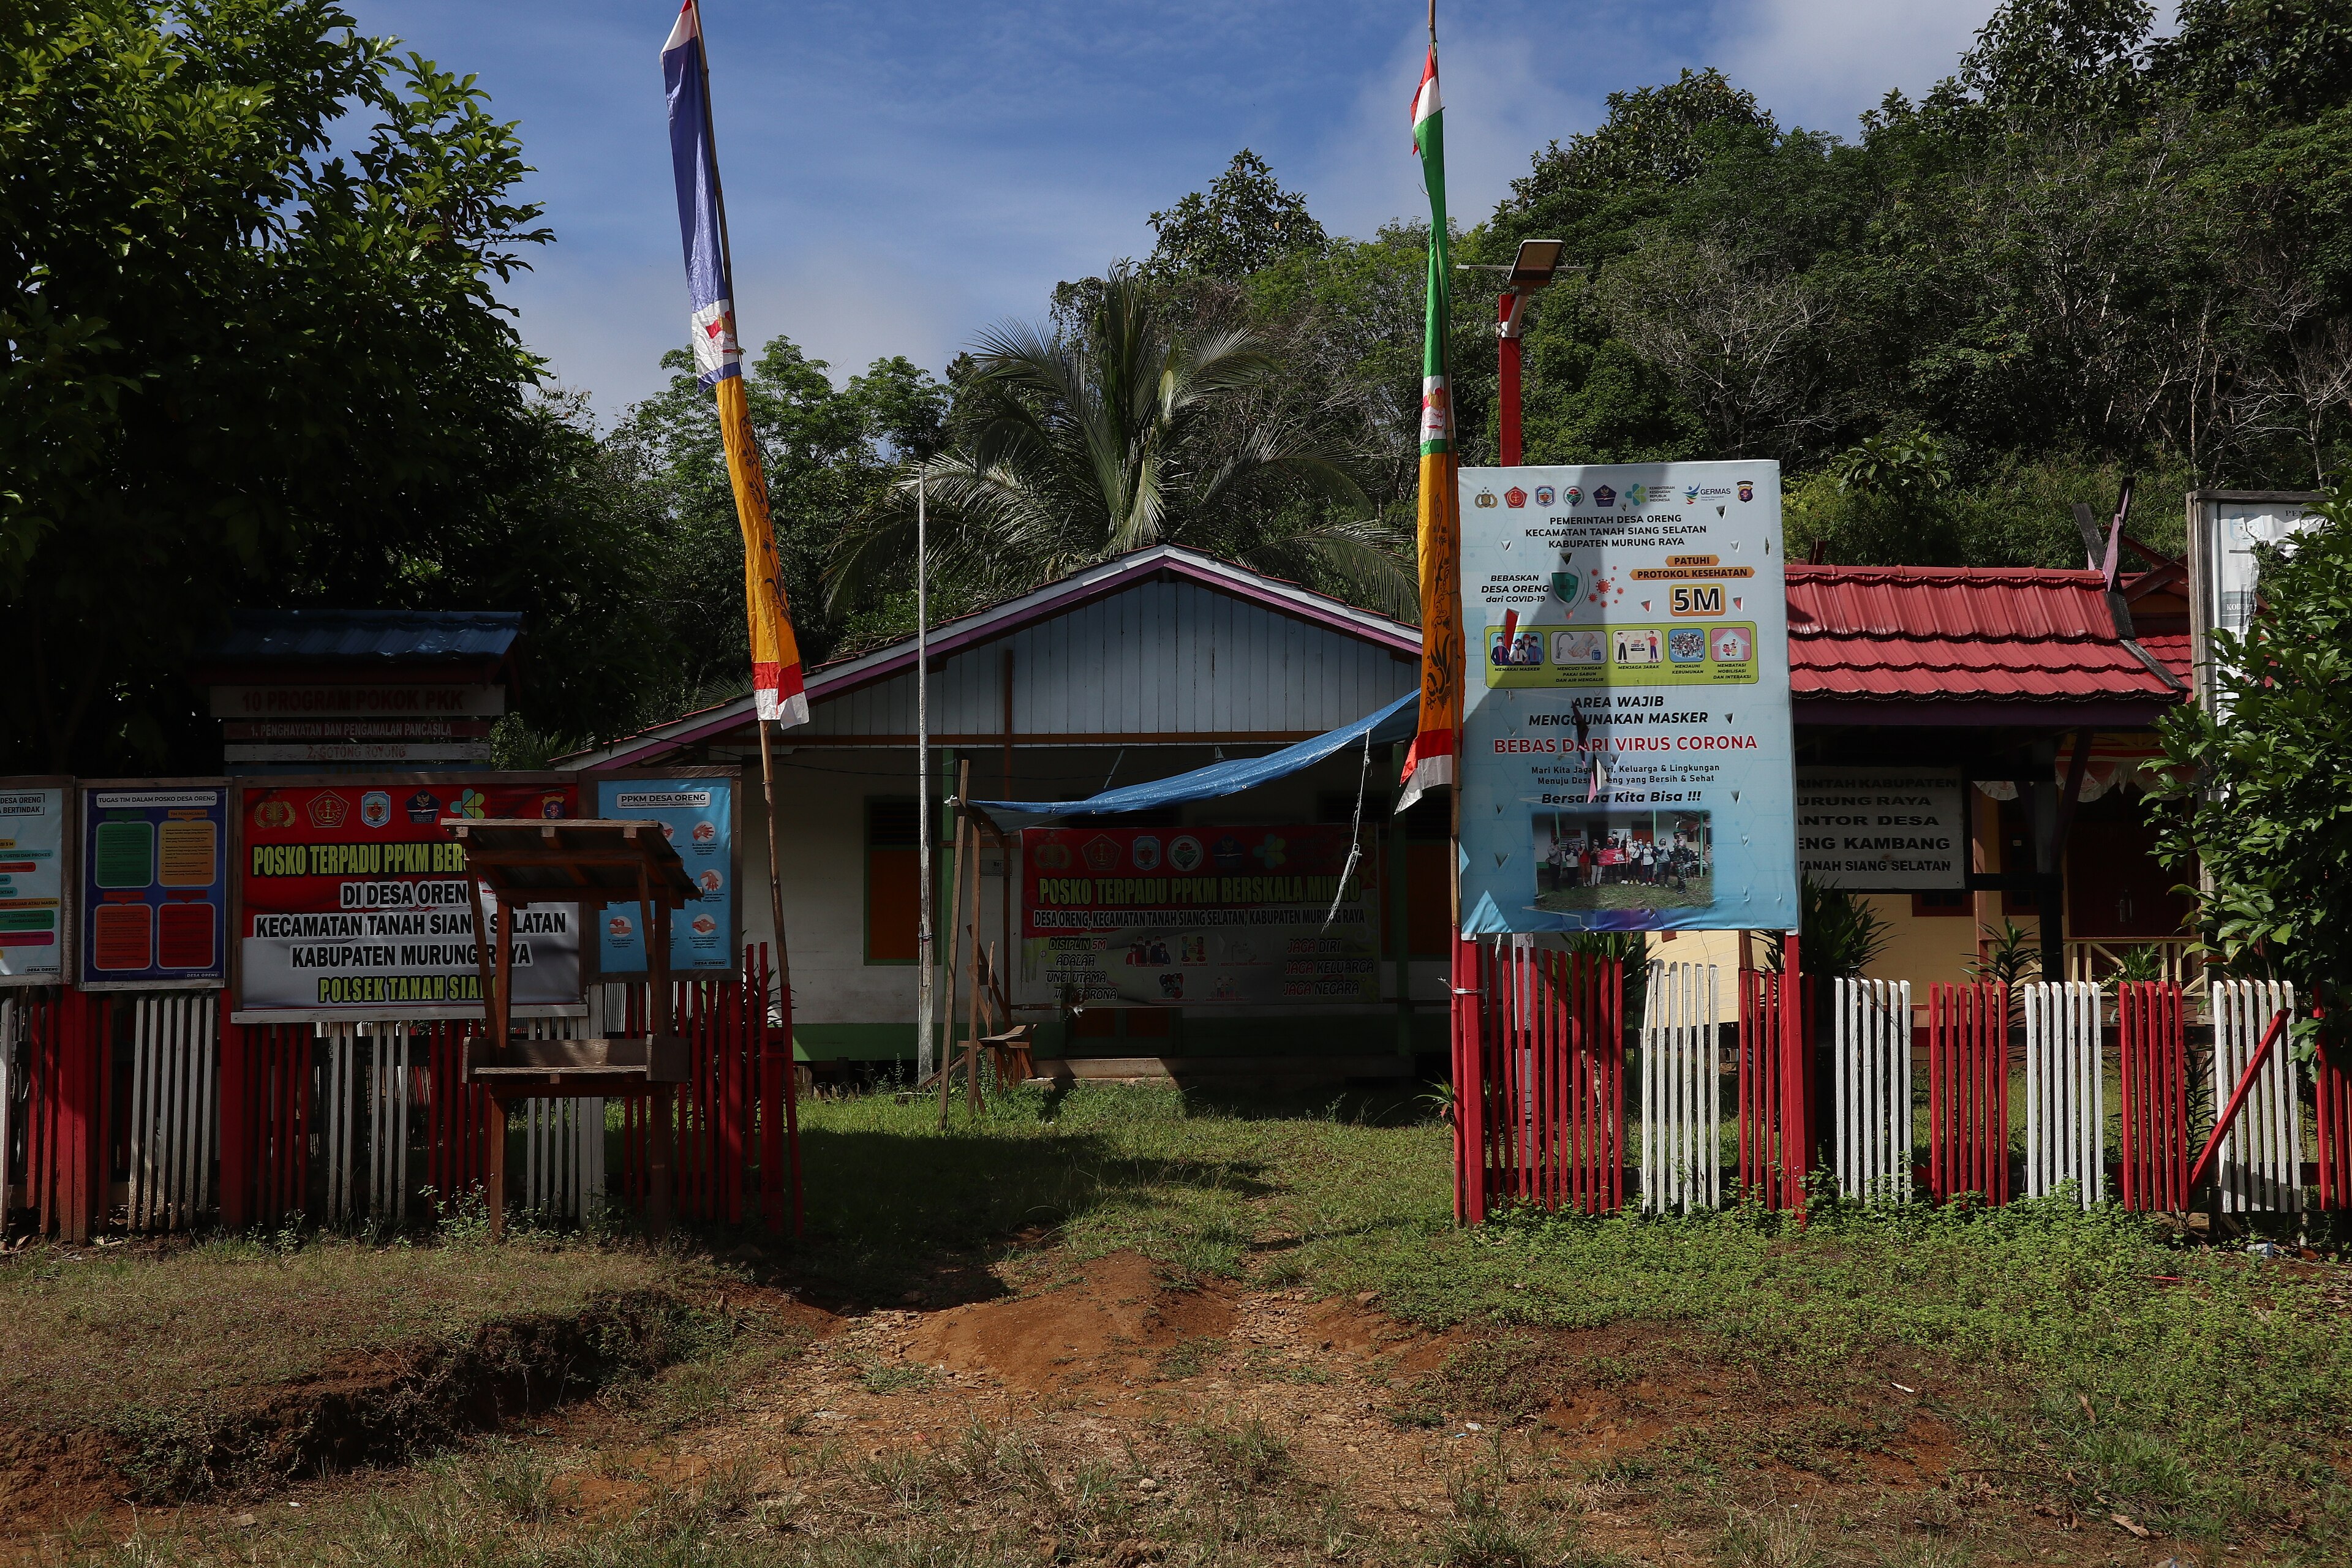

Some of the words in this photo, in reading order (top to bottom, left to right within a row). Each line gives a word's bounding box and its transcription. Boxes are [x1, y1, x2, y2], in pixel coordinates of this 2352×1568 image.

[1550, 516, 1613, 525] PEMERINTAH
[1616, 515, 1644, 524] DESA
[1525, 528, 1586, 537] KECAMATAN
[1589, 527, 1624, 536] TANAH
[1627, 527, 1659, 535] SIANG
[1662, 526, 1707, 534] SELATAN
[1548, 540, 1608, 548] KABUPATEN
[1611, 538, 1655, 547] MURUNG
[1692, 568, 1747, 578] KESEHATAN
[1675, 588, 1720, 611] 5M
[243, 692, 262, 711] 10
[267, 690, 351, 711] PROGRAM
[356, 690, 419, 710] POKOK
[425, 690, 465, 710] PKK
[1571, 697, 1612, 709] AREA
[1617, 696, 1664, 707] WAJIB
[1648, 712, 1708, 723] MASKER
[260, 724, 322, 737] PENGHAYATAN
[324, 723, 342, 736] DAN
[344, 723, 402, 736] PENGAMALAN
[404, 723, 452, 736] PANCASILA
[1494, 739, 1556, 753] BEBAS
[1615, 737, 1670, 751] VIRUS
[1677, 736, 1757, 750] CORONA
[319, 745, 361, 760] GOTONG
[1573, 766, 1593, 775] Jaga
[1619, 765, 1657, 774] Keluarga
[1670, 764, 1720, 773] Lingkungan
[1537, 777, 1569, 786] Menuju
[1796, 779, 1855, 788] RINTAH
[1858, 778, 1957, 788] KABUPATEN
[1614, 791, 1645, 802] Kita
[1650, 790, 1683, 802] Bisa
[1687, 791, 1702, 801] !!!
[1797, 796, 1872, 806] URUNG
[1876, 796, 1932, 806] RAYA
[1877, 816, 1940, 826] DESA
[1799, 837, 1836, 850] ENG
[1844, 837, 1950, 850] KAMBANG
[253, 845, 306, 875] POSKO
[309, 844, 380, 875] TERPADU
[383, 843, 429, 873] PPKM
[433, 843, 467, 872] BER
[1800, 861, 1841, 872] TANAH
[1845, 861, 1887, 871] SIANG
[1891, 860, 1951, 871] SELATAN
[343, 884, 361, 905] DI
[367, 884, 413, 905] DESA
[417, 883, 467, 905] OREN
[1039, 878, 1092, 905] POSKO
[1095, 878, 1167, 905] TERPADU
[1171, 877, 1218, 904] PPKM
[1221, 876, 1305, 903] BERSKALA
[256, 916, 363, 938] KECAMATAN
[368, 914, 425, 936] TANAH
[429, 914, 472, 935] SIAN
[489, 913, 566, 933] SLATAN
[1035, 911, 1058, 927] DESA
[1059, 911, 1092, 930] ORENG,
[1093, 911, 1146, 927] KECAMATAN
[1147, 911, 1177, 926] TANAH
[1178, 911, 1205, 926] SIANG
[1207, 910, 1248, 927] SELATAN,
[1250, 910, 1300, 925] KABUPATEN
[1343, 909, 1365, 924] RAYA
[1049, 938, 1091, 951] DISIPLIN
[1091, 938, 1107, 951] 5M
[1287, 938, 1316, 954] JAGA
[1318, 938, 1342, 953] DIRI
[292, 945, 396, 968] KABUPATEN
[401, 944, 479, 966] MURUNG
[487, 943, 531, 965] RYA
[1055, 954, 1096, 966] ADALAH
[1285, 960, 1314, 974] JAGA
[1316, 959, 1375, 974] KELUARGA
[1072, 971, 1107, 983] UTAMA
[319, 978, 385, 1001] POLSEK
[388, 977, 445, 1000] TANAH
[448, 976, 497, 1000] SIA
[1283, 981, 1313, 996] JAGA
[1314, 980, 1360, 995] NEGARA
